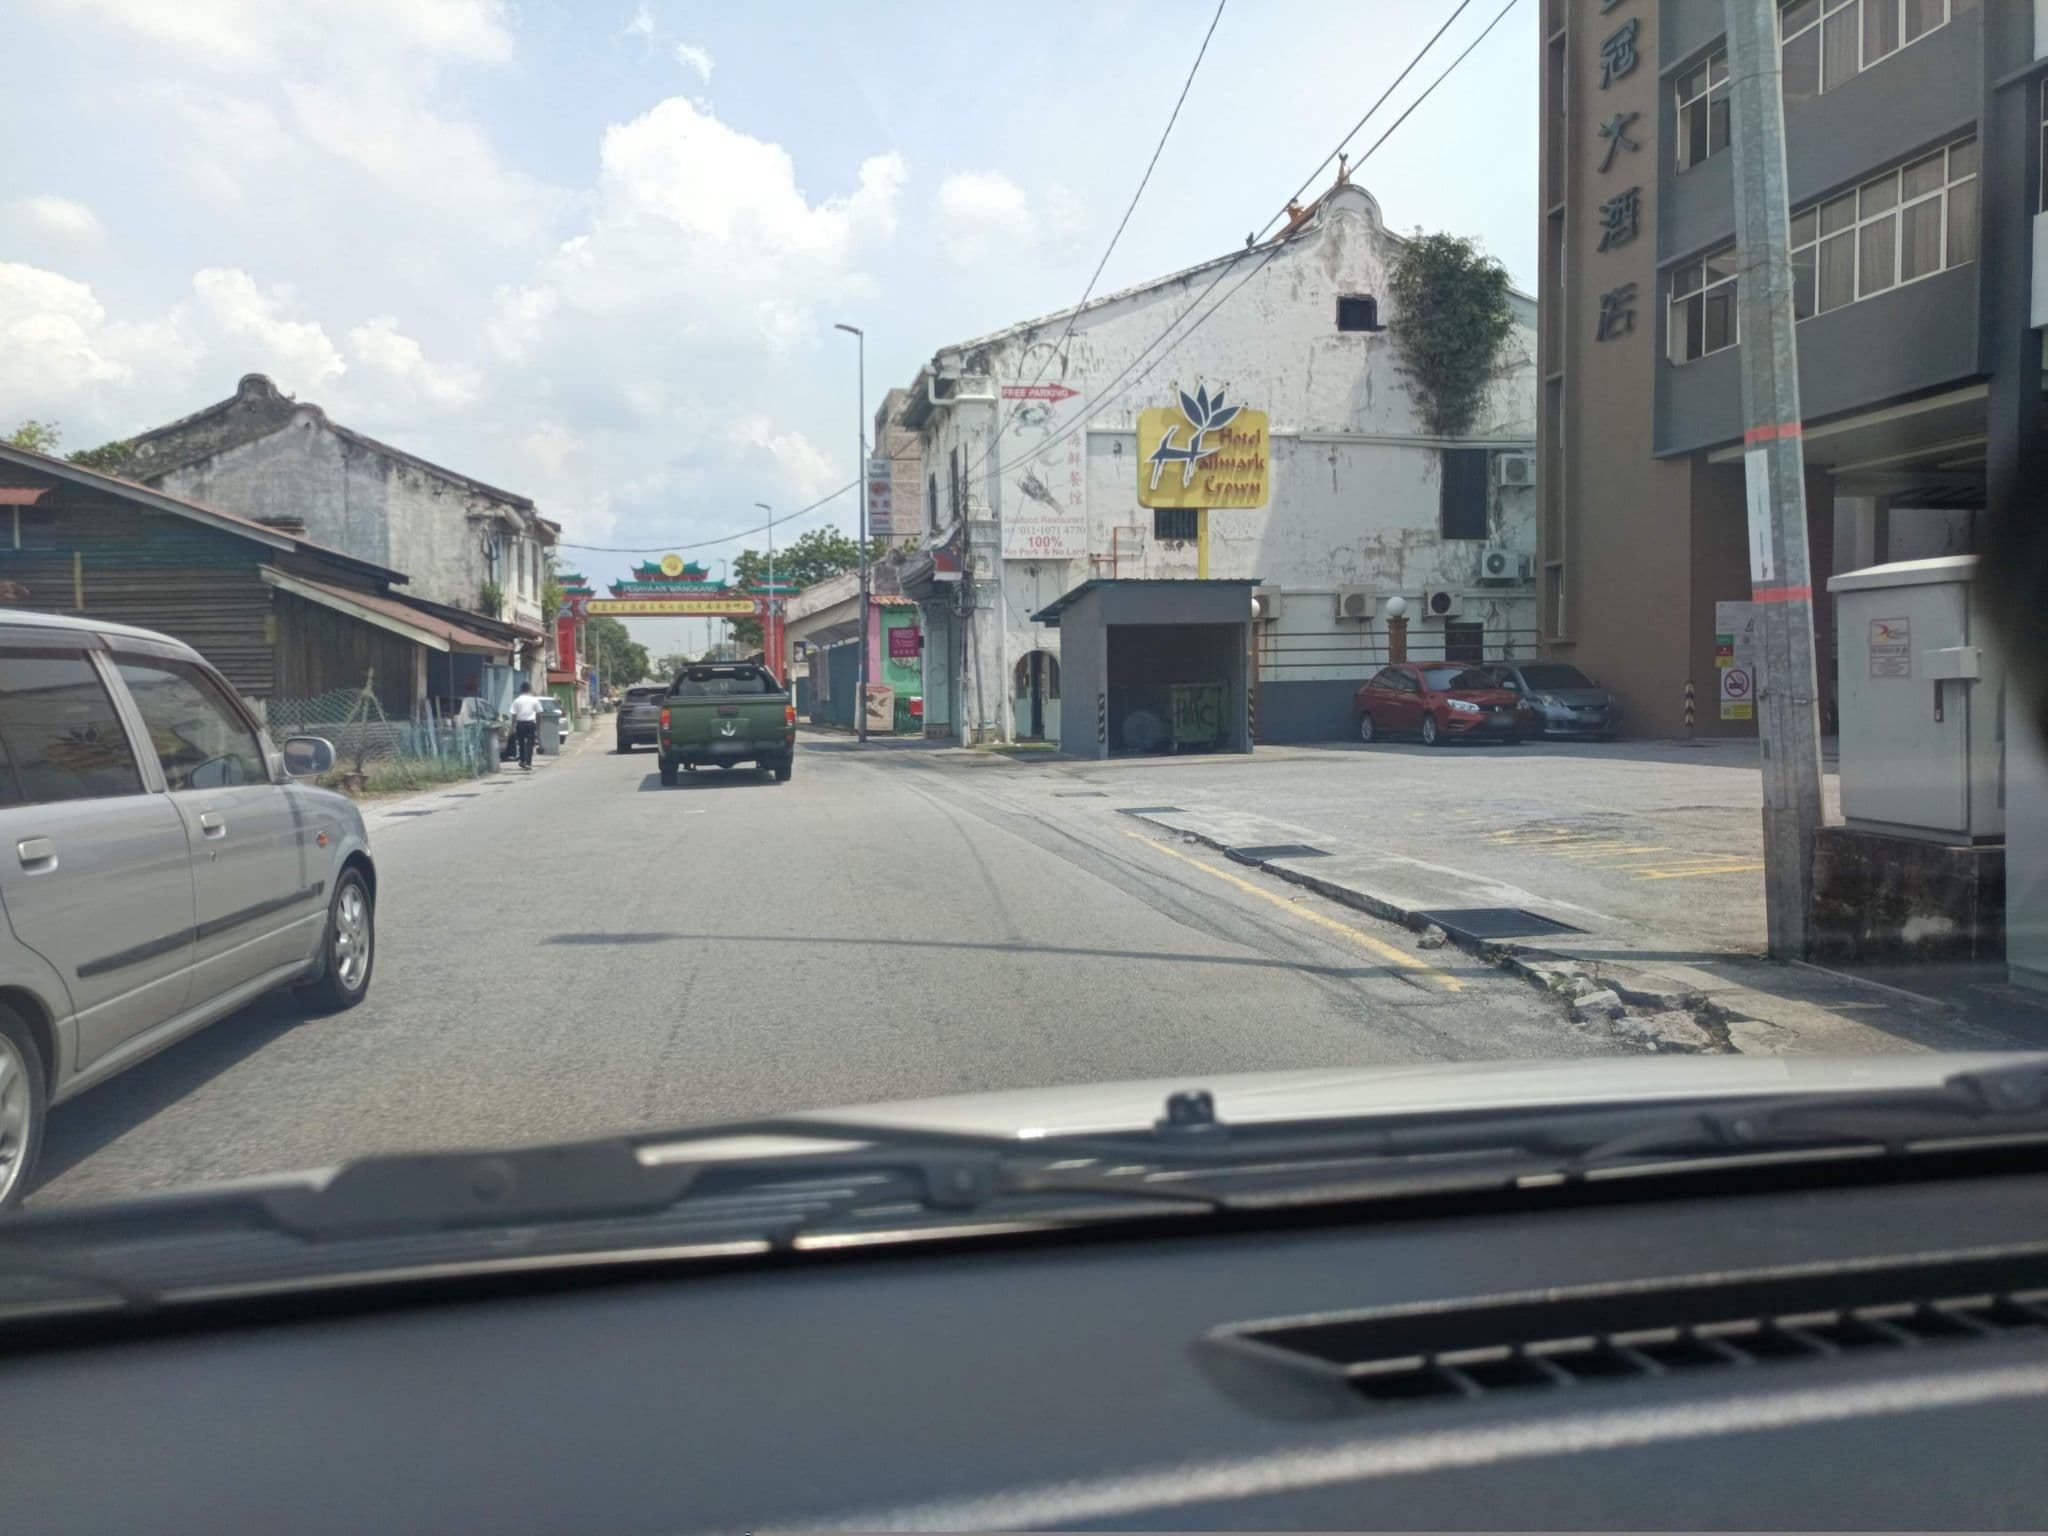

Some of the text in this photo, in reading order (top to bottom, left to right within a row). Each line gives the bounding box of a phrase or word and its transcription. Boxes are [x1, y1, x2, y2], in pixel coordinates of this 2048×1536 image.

[1596, 0, 1640, 343] 冠大酒店
[1003, 388, 1069, 397] FREE PARKING
[1219, 428, 1261, 444] Hotel
[1204, 476, 1261, 496] Crown
[1028, 536, 1063, 548] 100%
